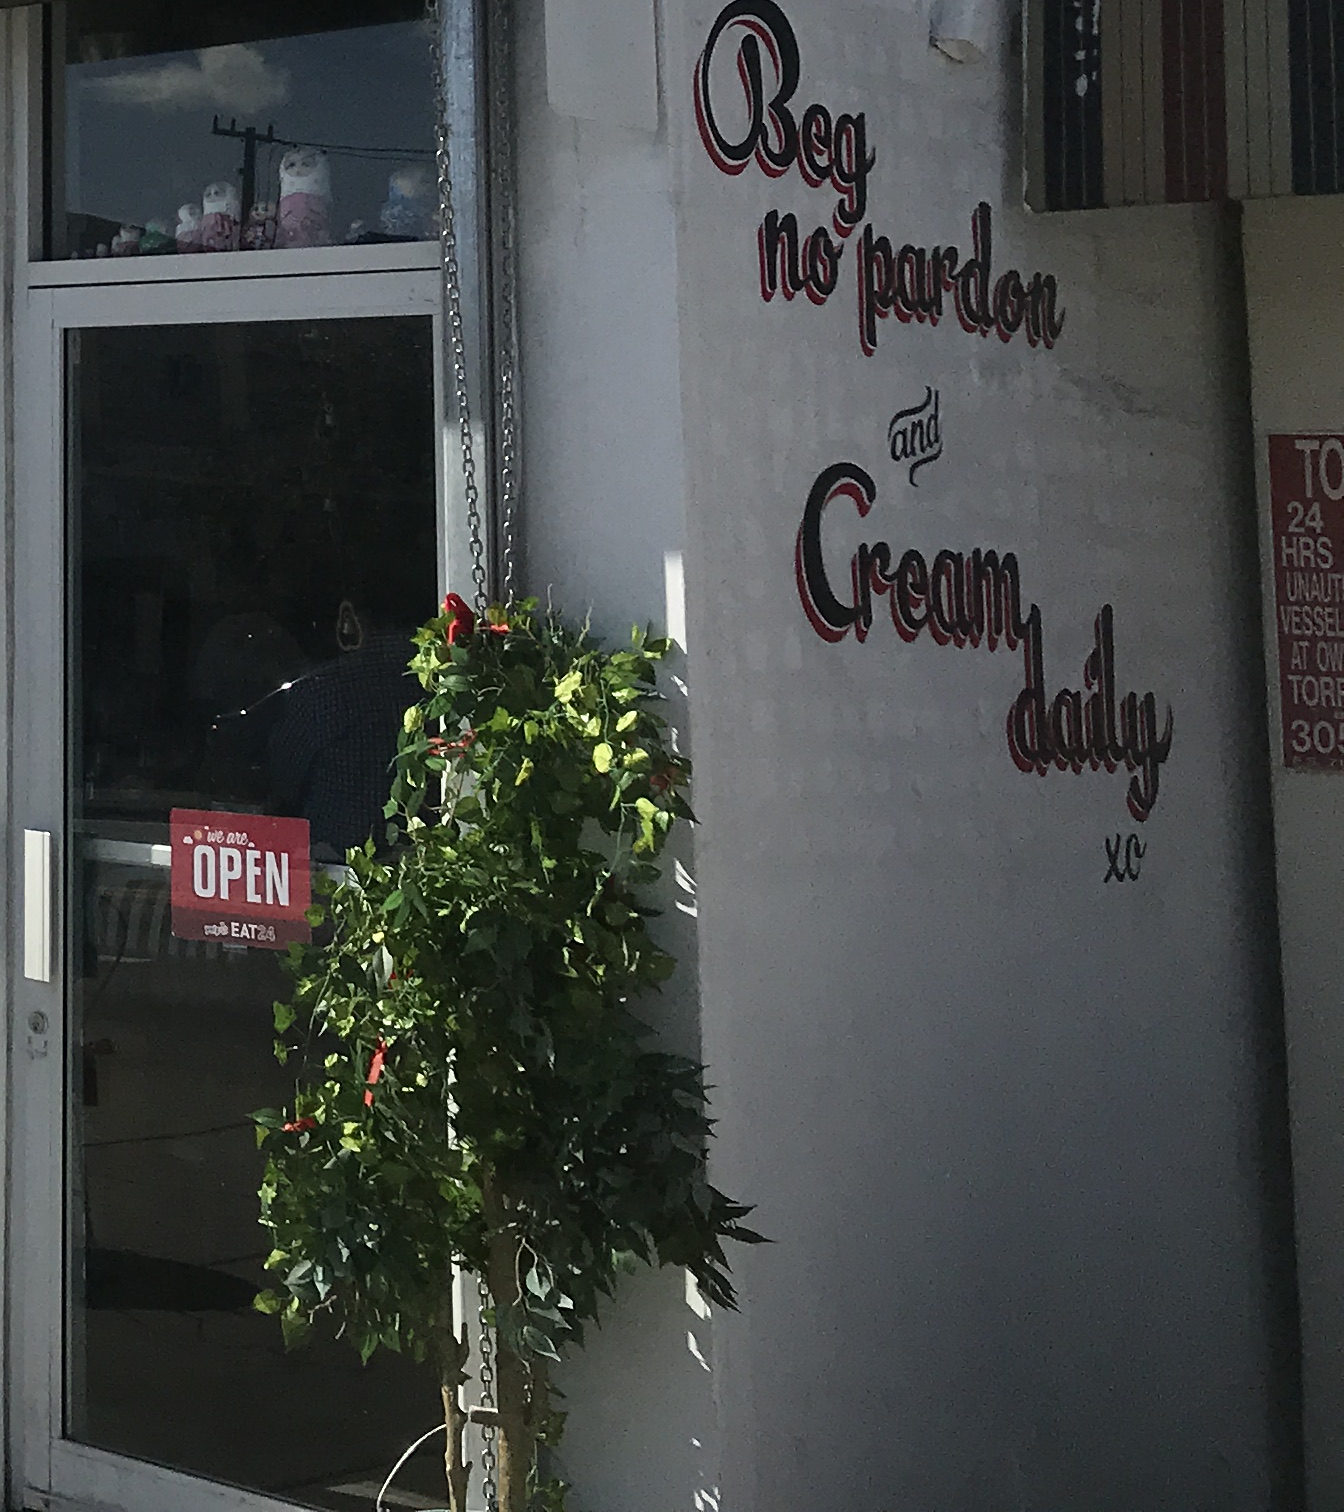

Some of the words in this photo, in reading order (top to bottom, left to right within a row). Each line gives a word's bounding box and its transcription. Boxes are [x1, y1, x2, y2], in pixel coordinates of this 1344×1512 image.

[758, 206, 843, 304] no
[858, 202, 1065, 357] pardon
[888, 386, 942, 487] and
[1287, 501, 1324, 534] 24
[796, 461, 1026, 651] Cream
[1281, 536, 1334, 569] HRS
[1286, 571, 1344, 603] UNAUT
[1291, 640, 1309, 671] AT
[1007, 604, 1171, 822] daily
[207, 830, 225, 844] we
[227, 832, 249, 846] are
[193, 844, 290, 907] OPEN
[231, 921, 276, 942] EAT24
